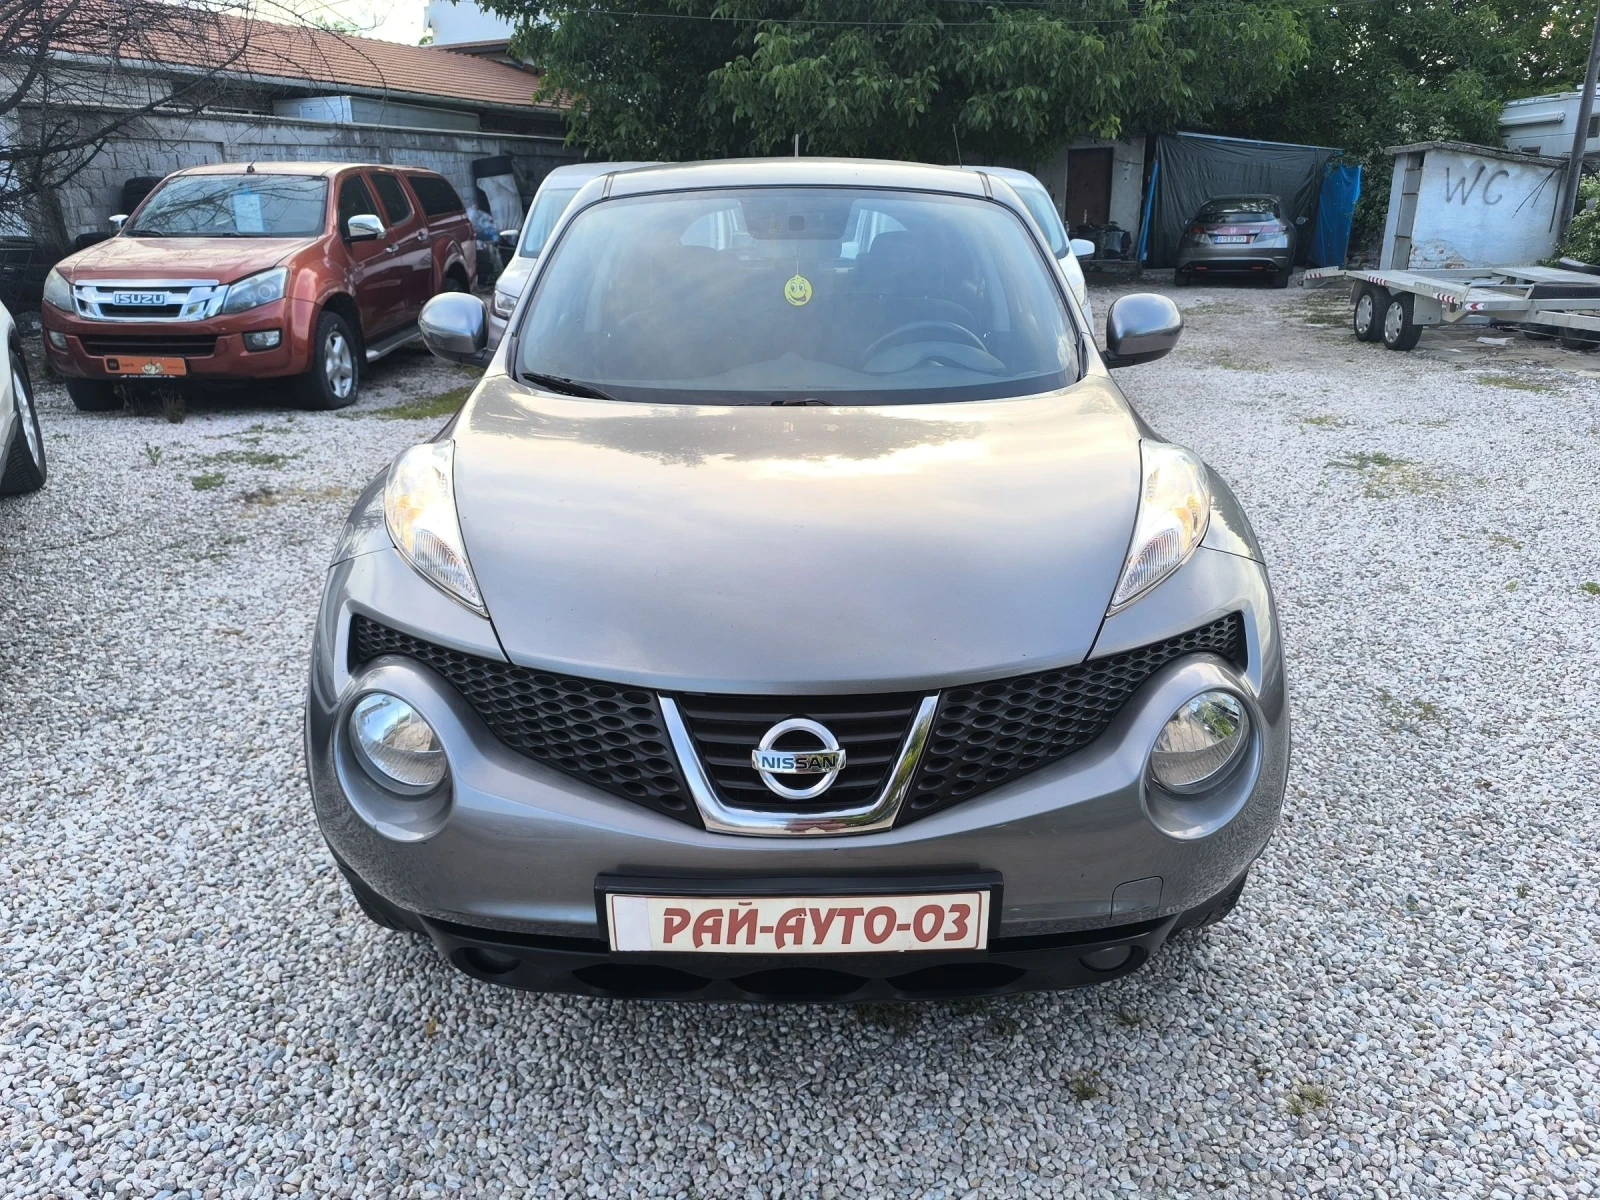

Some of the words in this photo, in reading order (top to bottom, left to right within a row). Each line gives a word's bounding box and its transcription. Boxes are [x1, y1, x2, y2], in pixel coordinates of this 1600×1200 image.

[1446, 165, 1510, 206] WC
[115, 294, 164, 304] ISUZU
[761, 755, 836, 769] NISSAN
